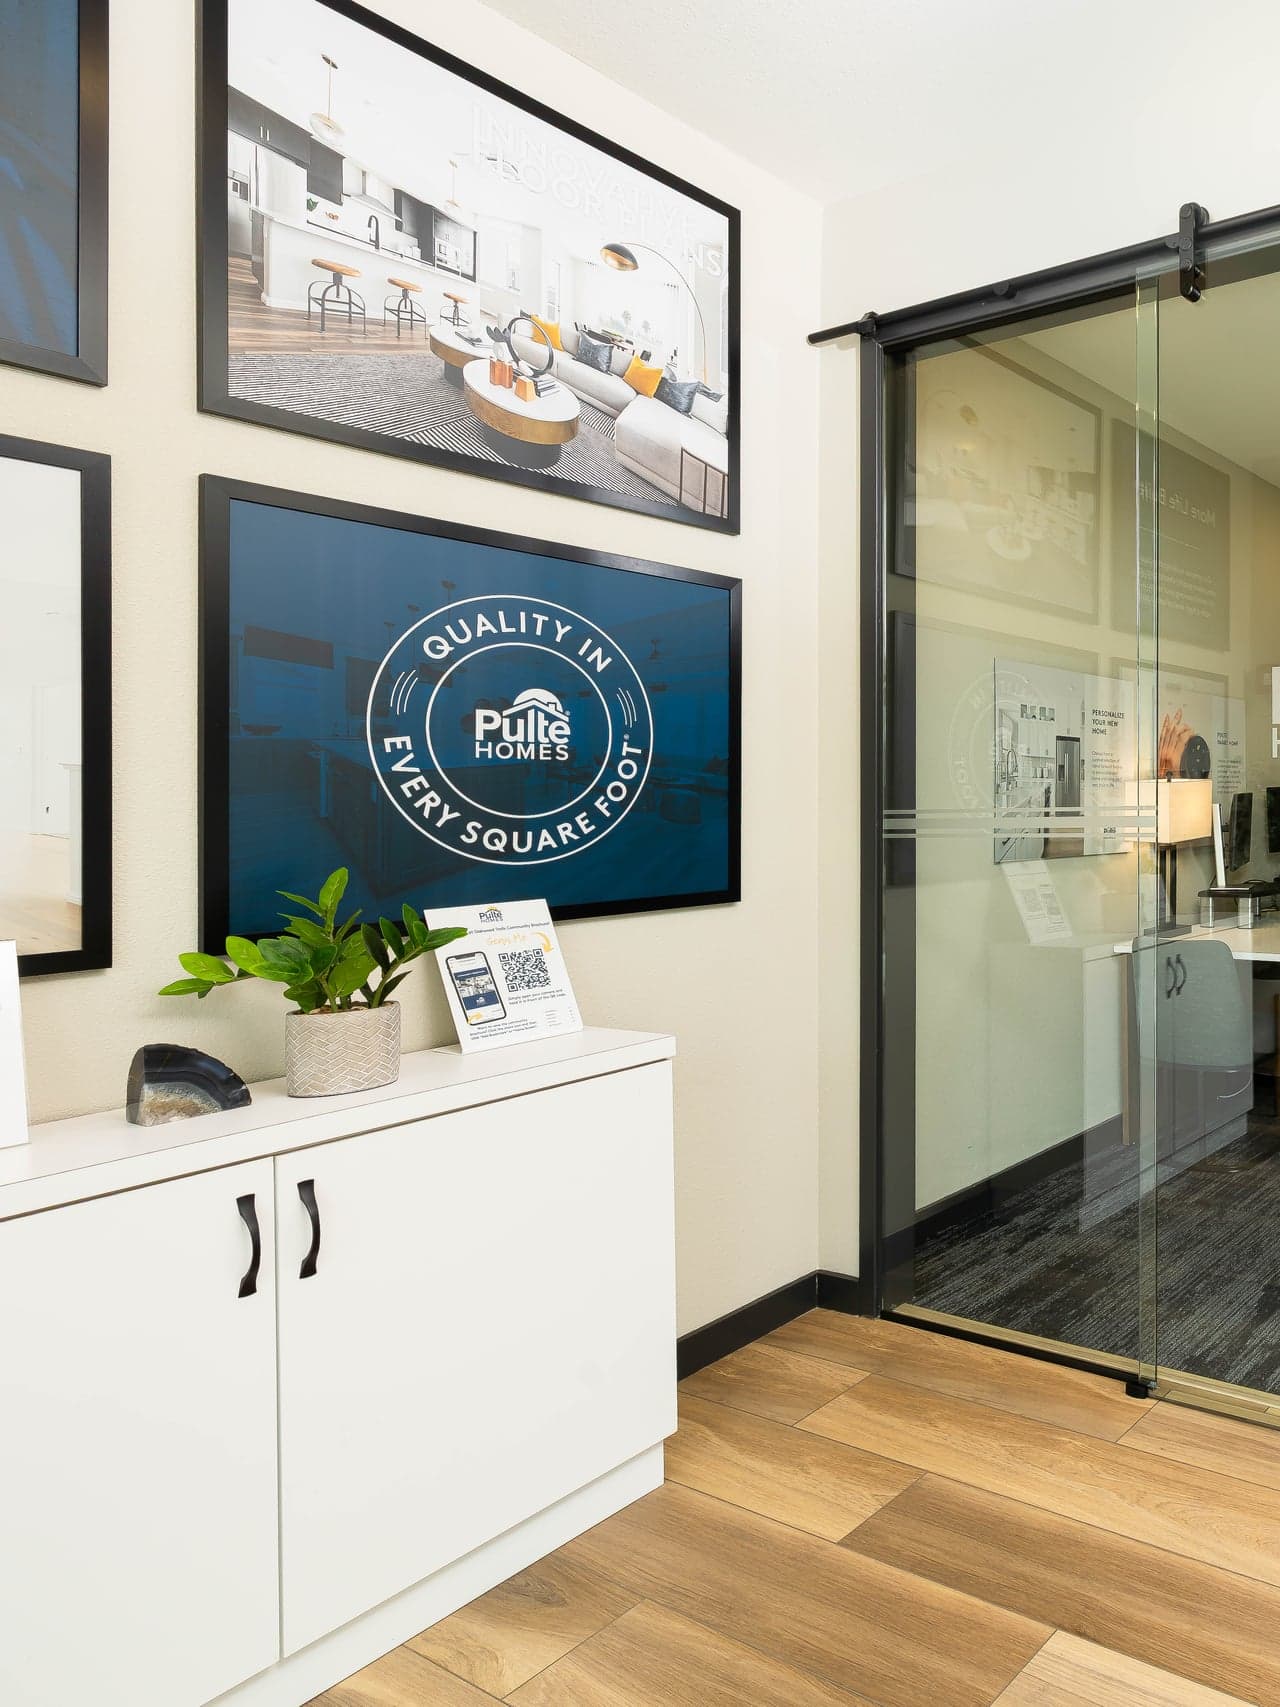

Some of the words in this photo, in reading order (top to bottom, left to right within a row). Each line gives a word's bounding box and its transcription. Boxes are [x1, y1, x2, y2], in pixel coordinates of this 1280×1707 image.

[423, 610, 572, 660] QUALITY
[578, 638, 612, 673] IN
[475, 707, 571, 744] Pulte
[1092, 709, 1125, 719] PERSONALIZE
[1092, 718, 1106, 726] YOUR
[475, 741, 570, 761] HOMES
[383, 735, 461, 829] EVERY
[460, 811, 596, 853] SQUARE
